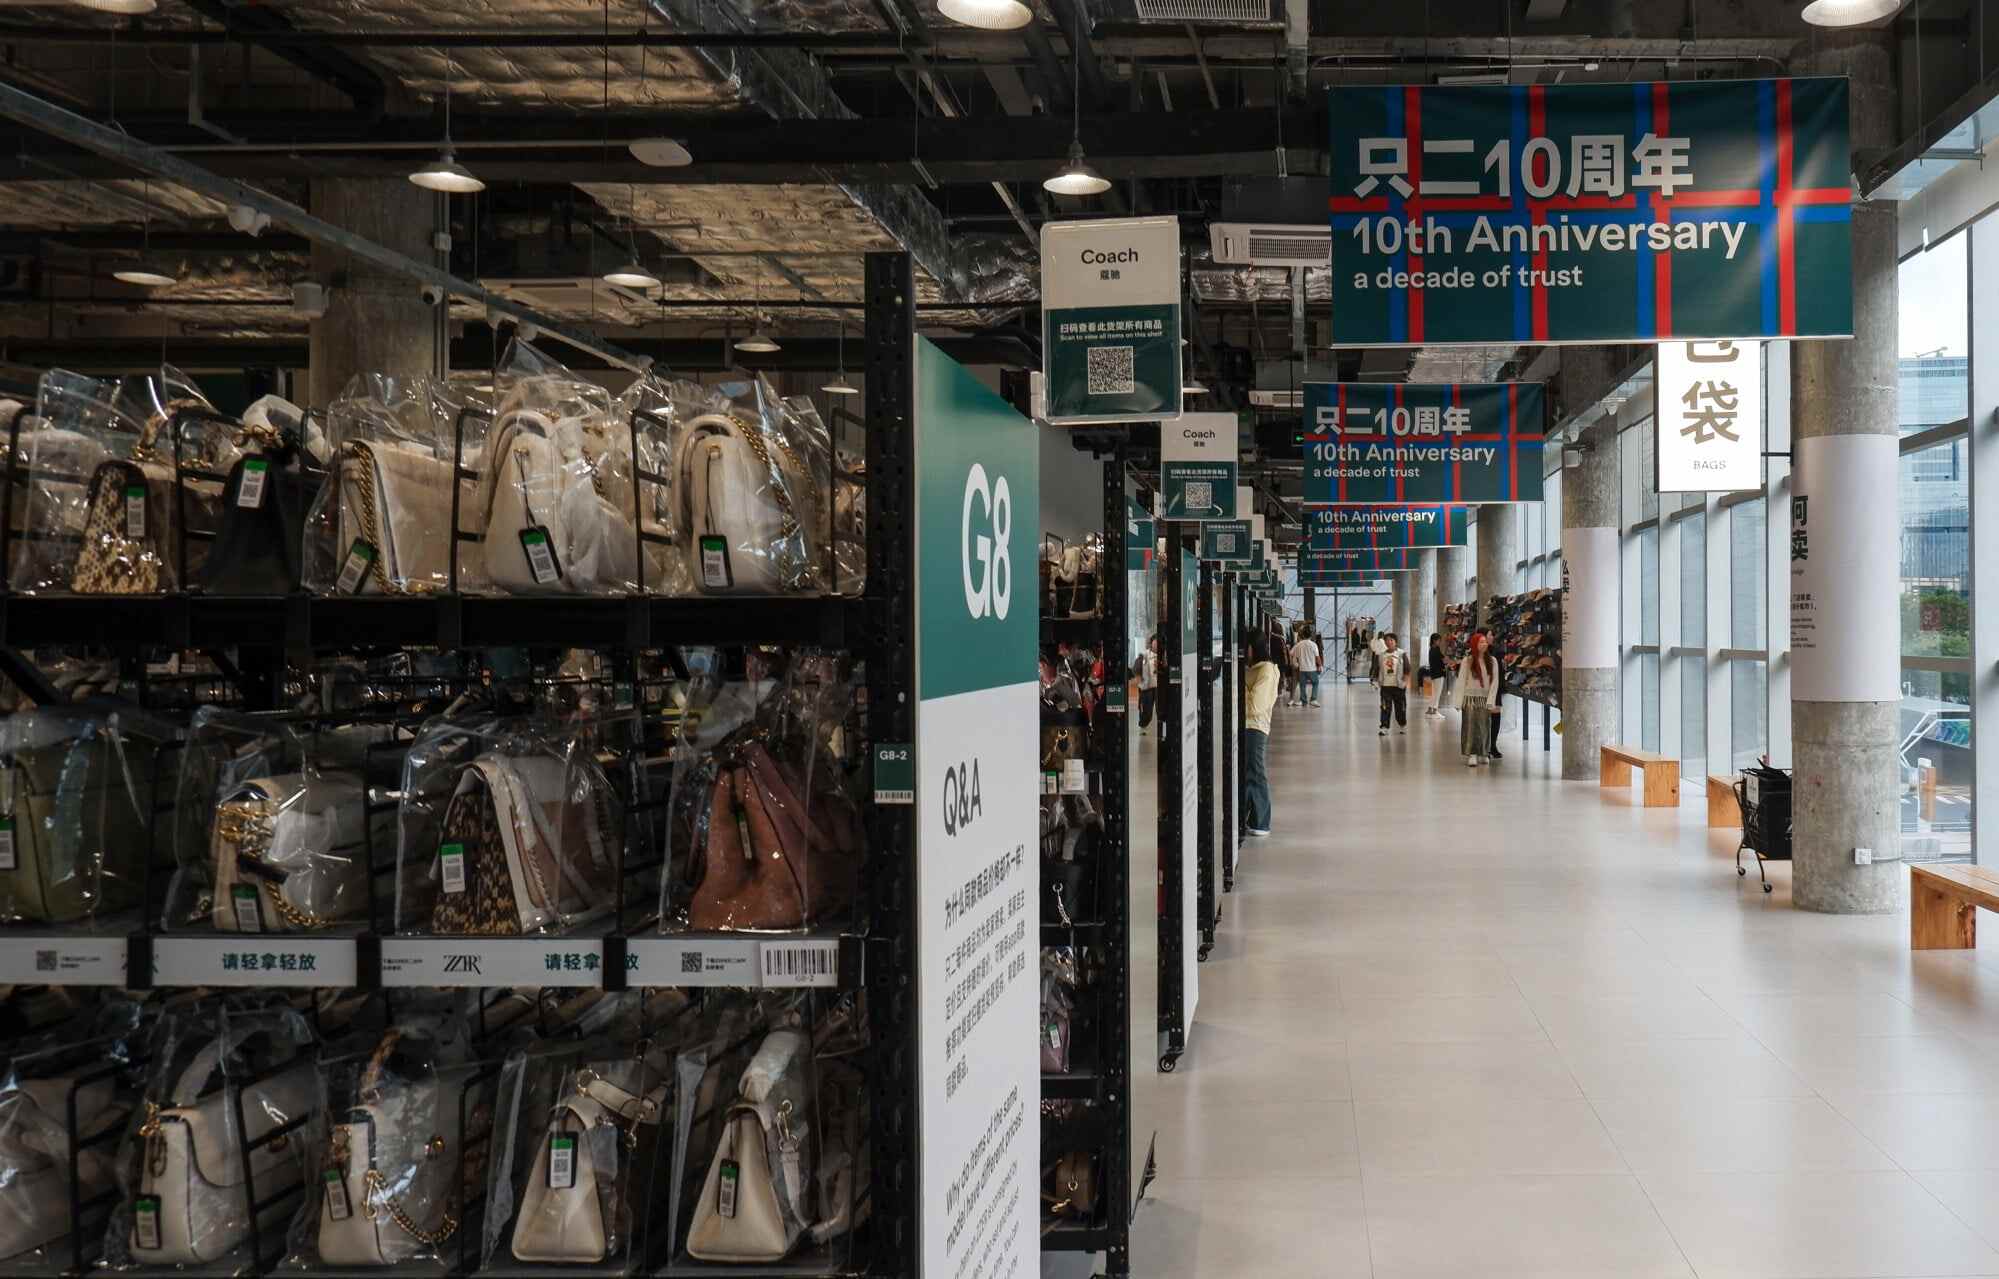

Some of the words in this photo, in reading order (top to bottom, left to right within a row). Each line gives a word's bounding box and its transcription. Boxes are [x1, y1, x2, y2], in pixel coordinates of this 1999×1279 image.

[1353, 134, 1694, 199] 只二10周年
[1353, 216, 1452, 255] 10th
[1466, 215, 1746, 258] Anniversary
[1081, 248, 1139, 265] Coach
[1353, 271, 1368, 289] a
[1375, 264, 1475, 289] decade
[1482, 264, 1511, 288] of
[1518, 265, 1584, 288] trust
[1314, 406, 1472, 435] 只二10周年
[1183, 429, 1216, 439] Coach
[1313, 443, 1359, 462] 10th
[1366, 443, 1496, 465] Anniversary
[1693, 460, 1727, 470] BAGS
[1313, 469, 1321, 478] a
[1324, 466, 1371, 478] decade
[1373, 466, 1387, 478] of
[1390, 466, 1420, 478] trust
[1317, 510, 1348, 524] 10th
[1352, 509, 1436, 524] Anniversary
[1324, 526, 1354, 534] decade
[1356, 525, 1366, 534] of
[1367, 525, 1387, 533] trust
[962, 462, 1011, 621] G8
[880, 749, 907, 761] G8-2
[943, 757, 982, 838] Q&A
[222, 952, 317, 972] 请轻拿轻放
[946, 1178, 961, 1216] Why
[961, 1161, 970, 1188] do
[986, 1116, 993, 1144] of
[946, 1200, 966, 1256] model
[966, 1181, 981, 1219] have
